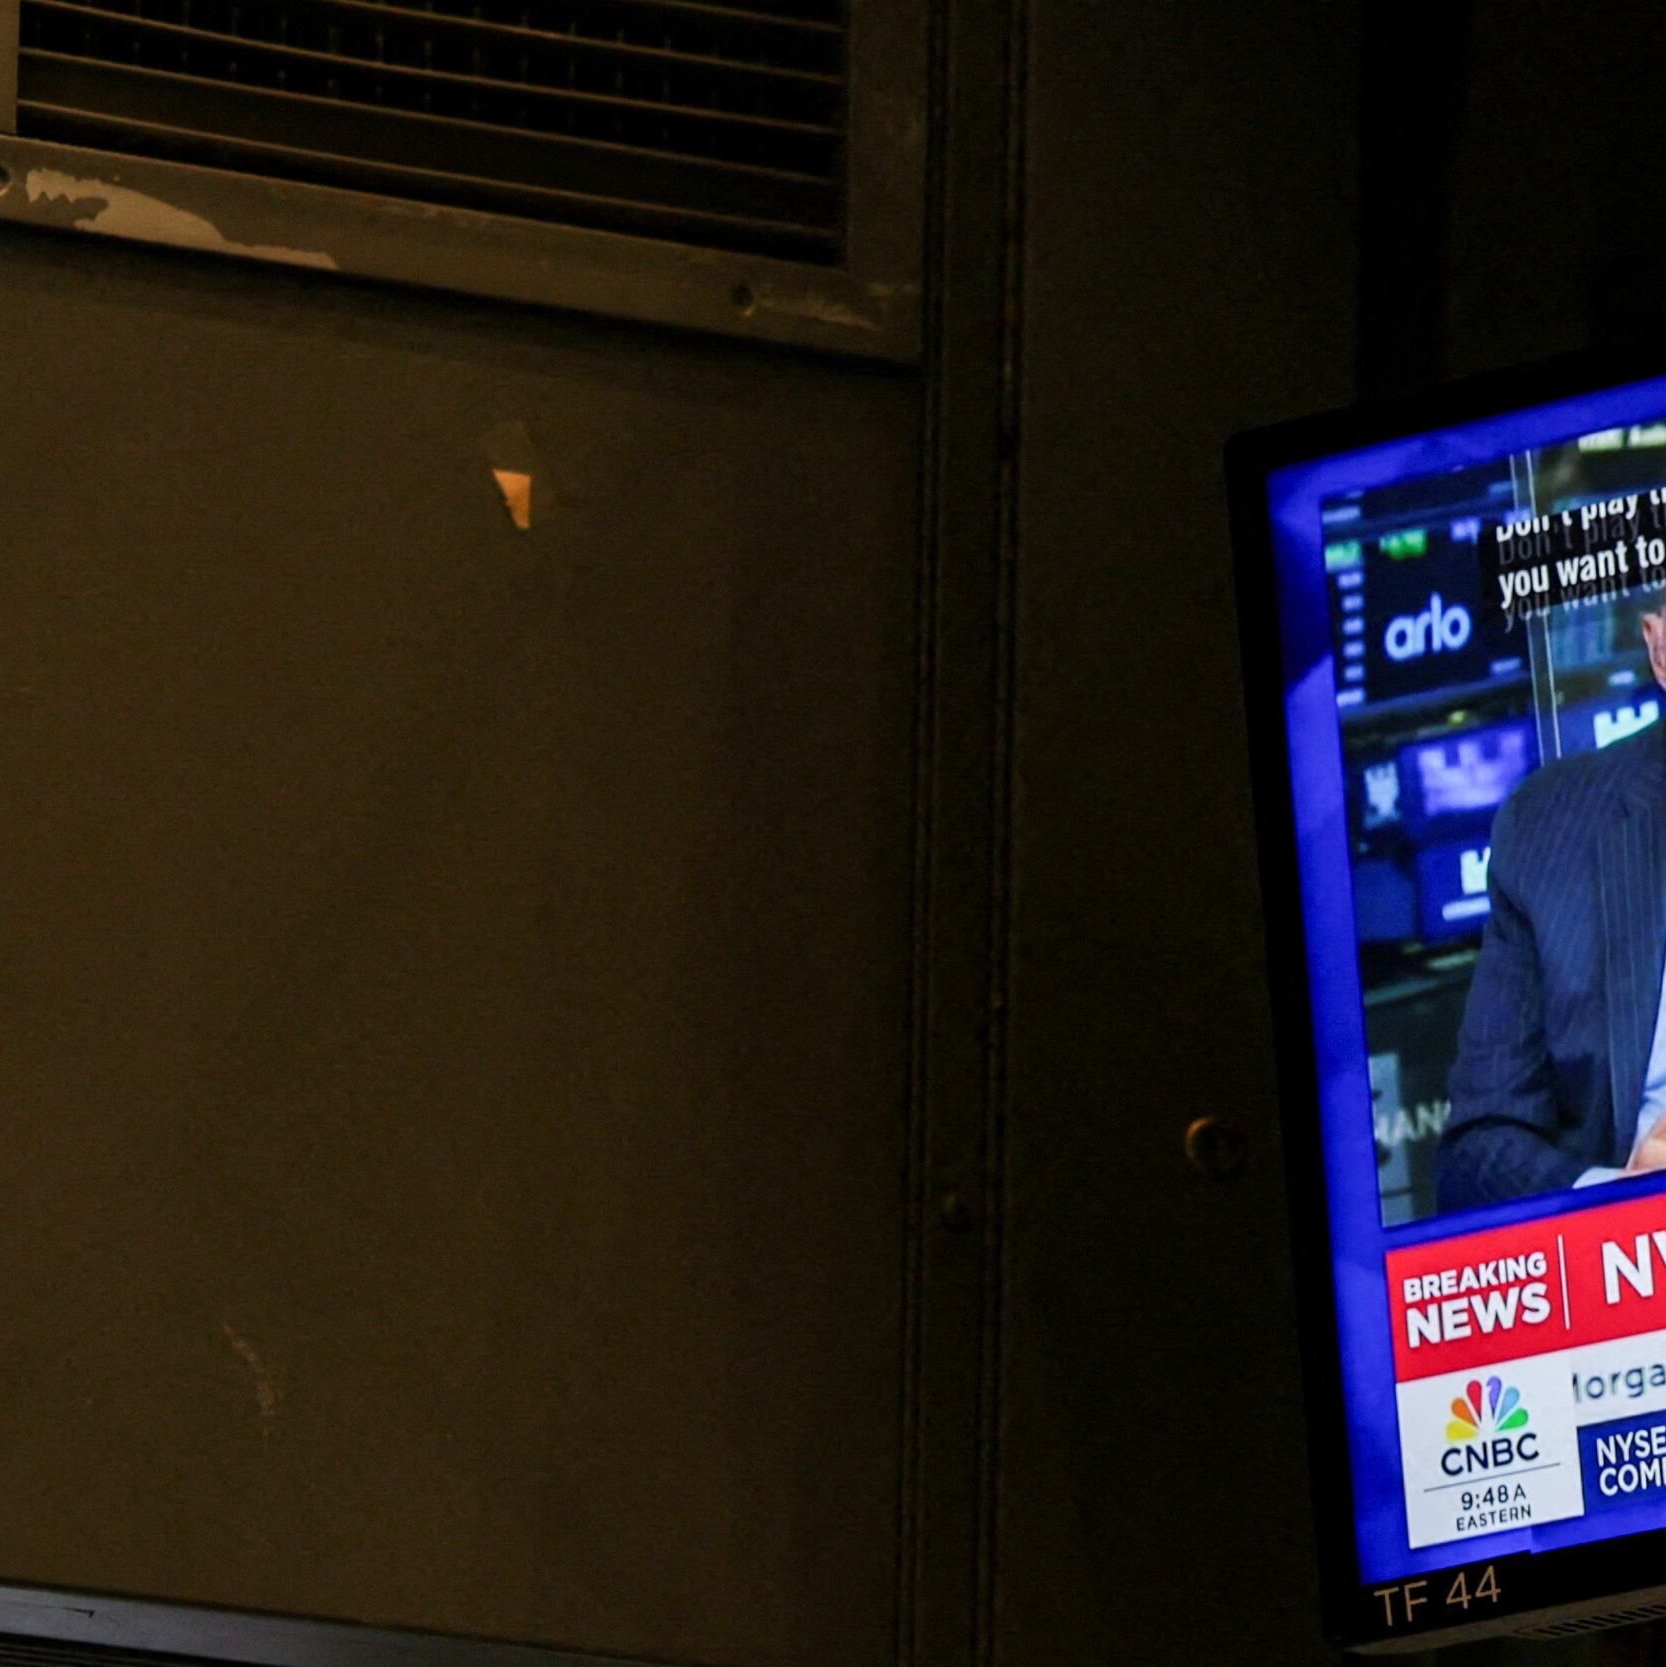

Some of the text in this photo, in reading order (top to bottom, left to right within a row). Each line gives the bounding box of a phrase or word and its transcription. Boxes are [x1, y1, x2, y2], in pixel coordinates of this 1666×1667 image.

[1498, 567, 1550, 609] you
[1557, 549, 1629, 587] want
[1636, 538, 1665, 568] to
[1384, 592, 1471, 661] arlo
[1404, 1252, 1548, 1304] BREAKING
[1406, 1283, 1551, 1349] NEWS
[1441, 1432, 1541, 1478] CNBC
[1456, 1504, 1532, 1532] EASTERN
[1375, 1565, 1502, 1627] TF 44
